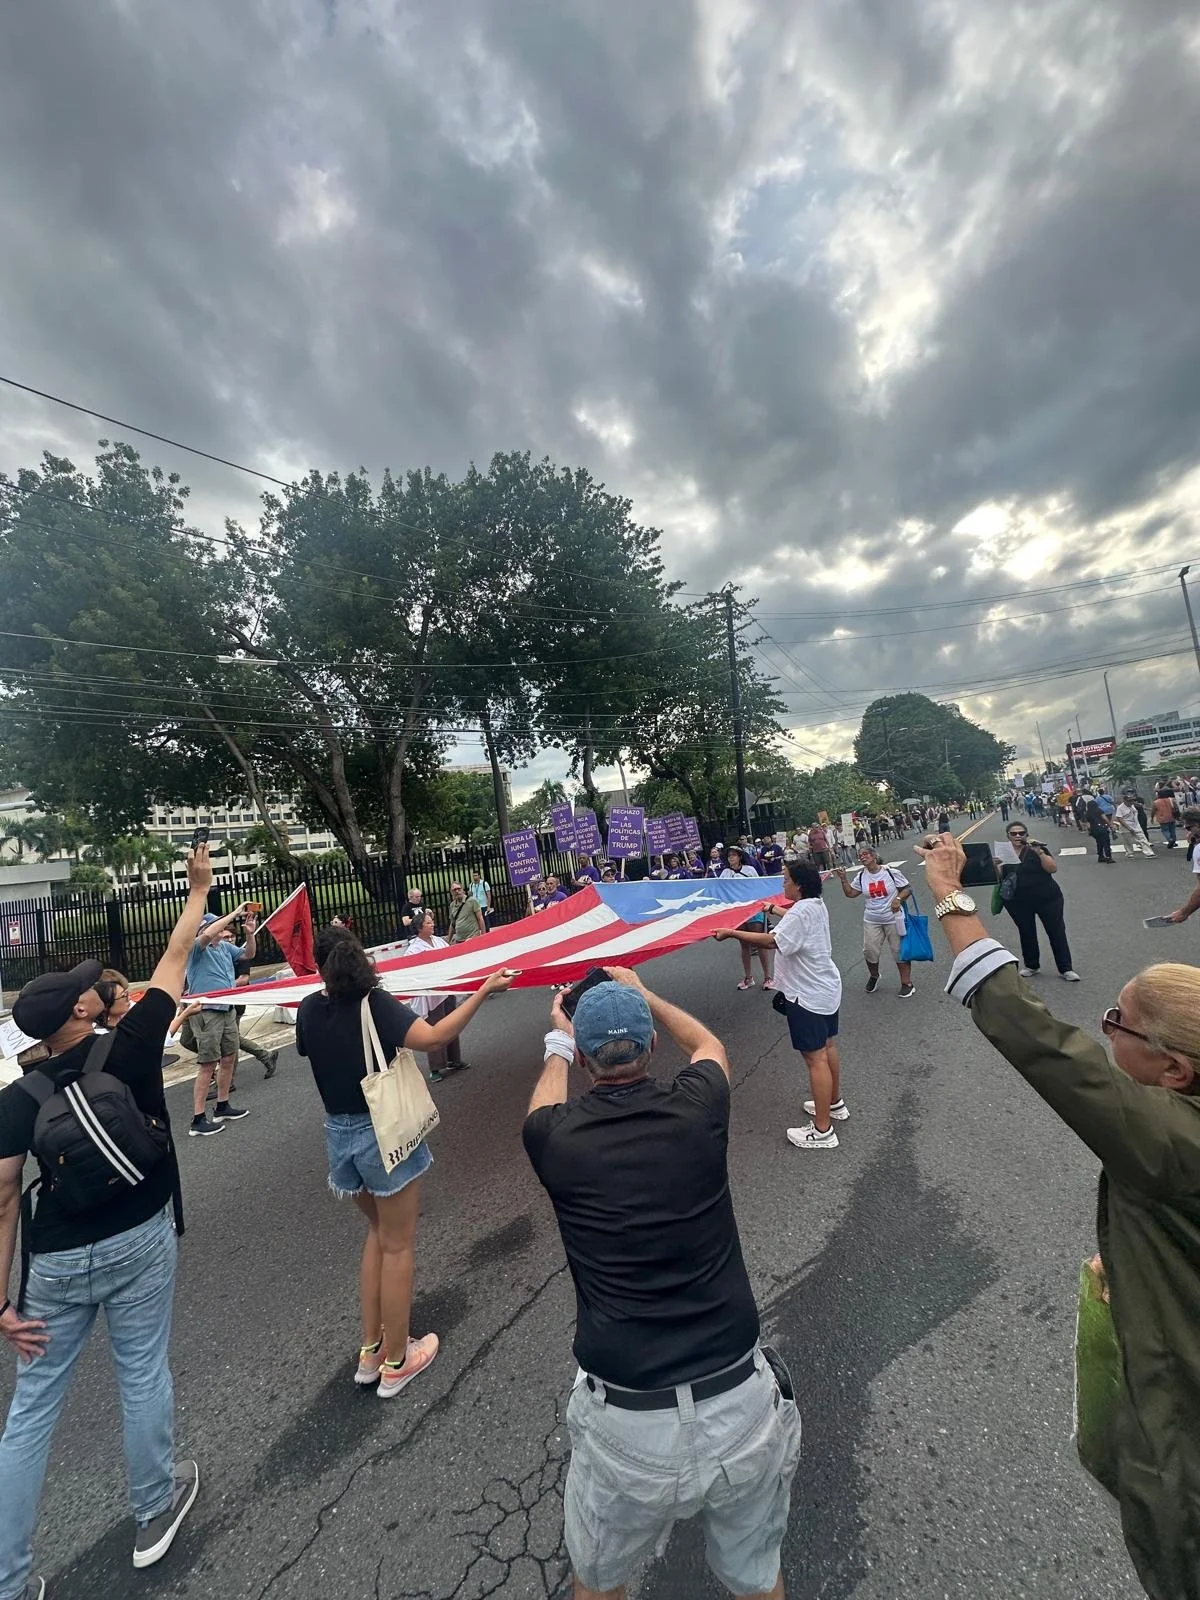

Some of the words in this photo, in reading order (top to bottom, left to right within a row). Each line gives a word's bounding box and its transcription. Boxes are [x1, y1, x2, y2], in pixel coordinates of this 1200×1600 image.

[504, 836, 525, 844] FUERA
[510, 842, 530, 852] JUNTA
[510, 857, 538, 868] CONTROL
[514, 866, 536, 875] FISCAL
